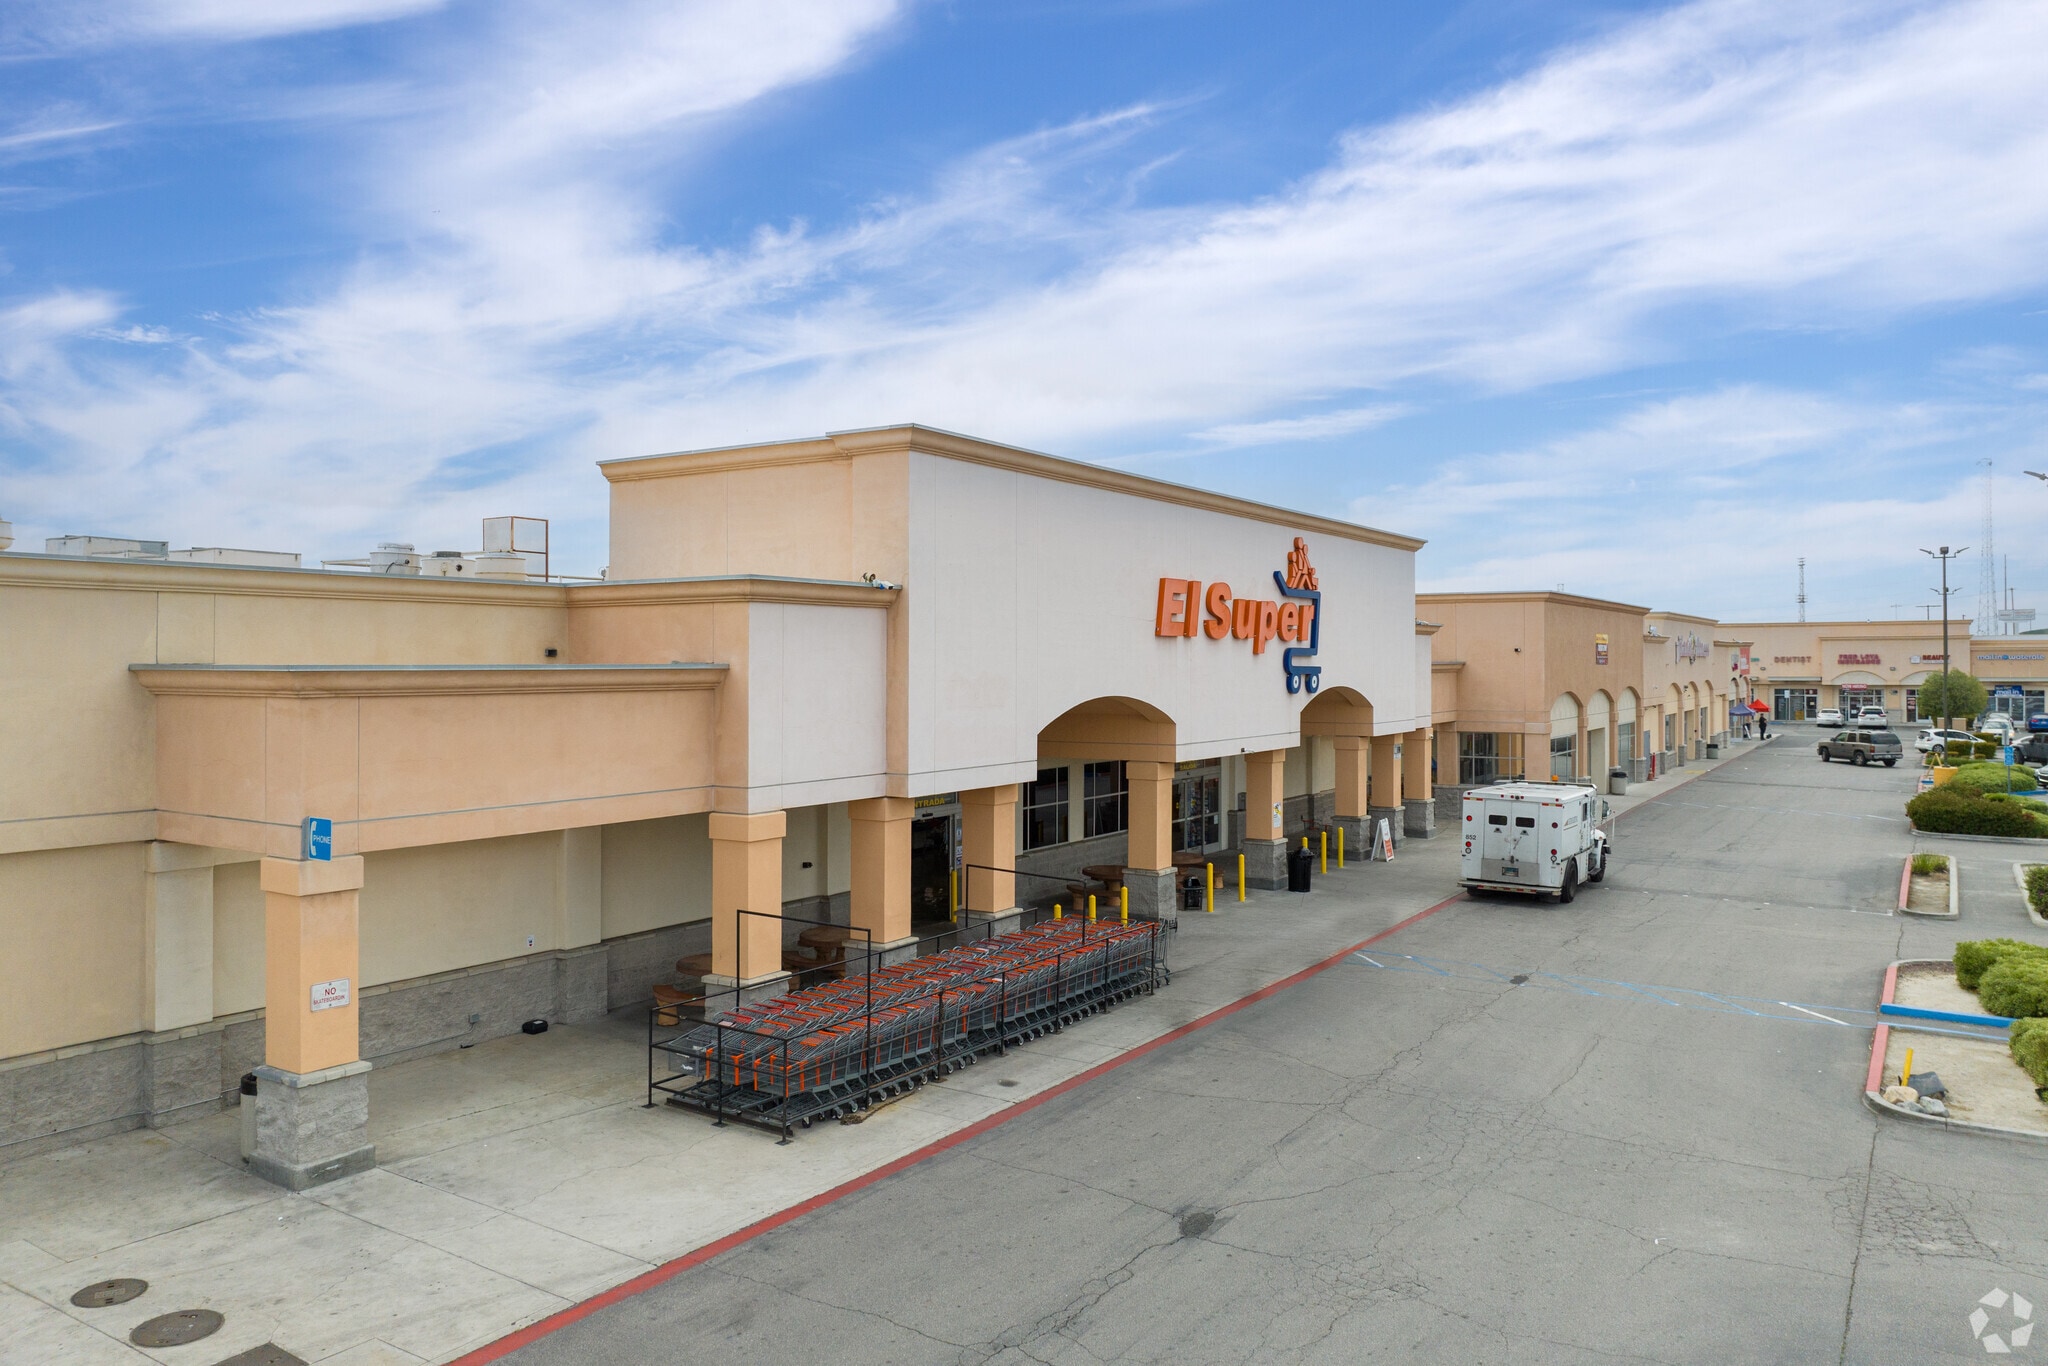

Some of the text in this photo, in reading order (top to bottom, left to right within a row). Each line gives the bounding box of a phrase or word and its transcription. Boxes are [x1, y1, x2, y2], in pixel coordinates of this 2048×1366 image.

[1155, 577, 1315, 655] El Super
[1774, 656, 1812, 664] DENTIST
[915, 798, 945, 808] NTRADA
[313, 834, 331, 844] PHONE
[324, 987, 337, 996] NO
